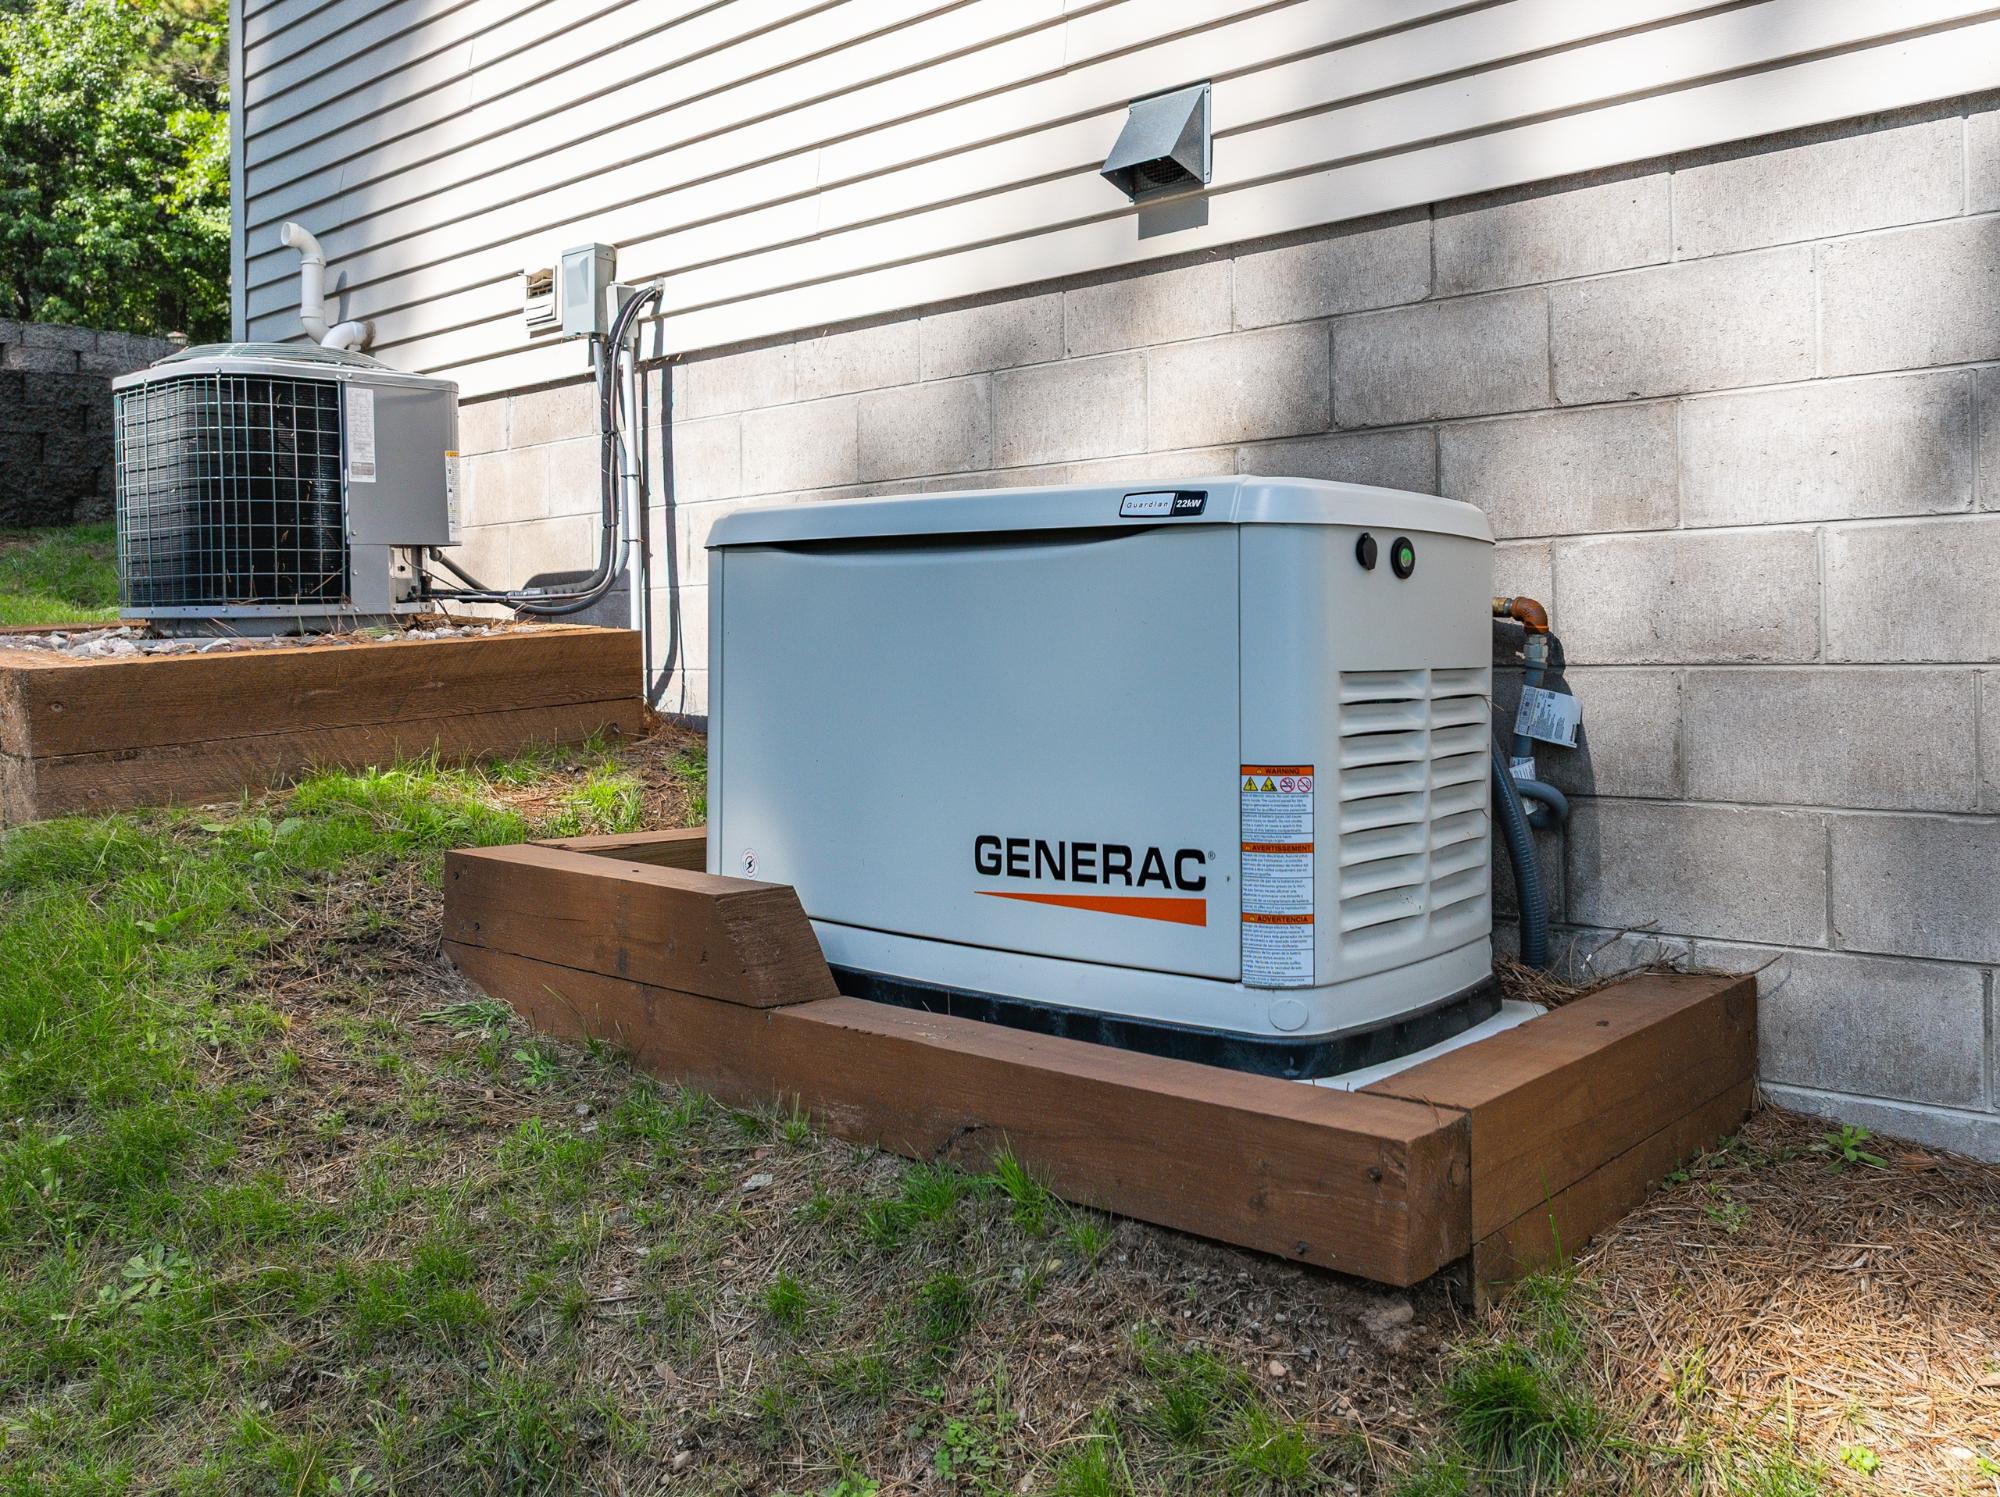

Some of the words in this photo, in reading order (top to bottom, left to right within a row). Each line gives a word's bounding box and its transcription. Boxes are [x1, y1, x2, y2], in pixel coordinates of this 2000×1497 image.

[1126, 501, 1169, 509] Guardian
[1175, 499, 1203, 508] 22kW
[1265, 767, 1300, 775] WARNING
[1257, 915, 1308, 923] ADVERTENCIA
